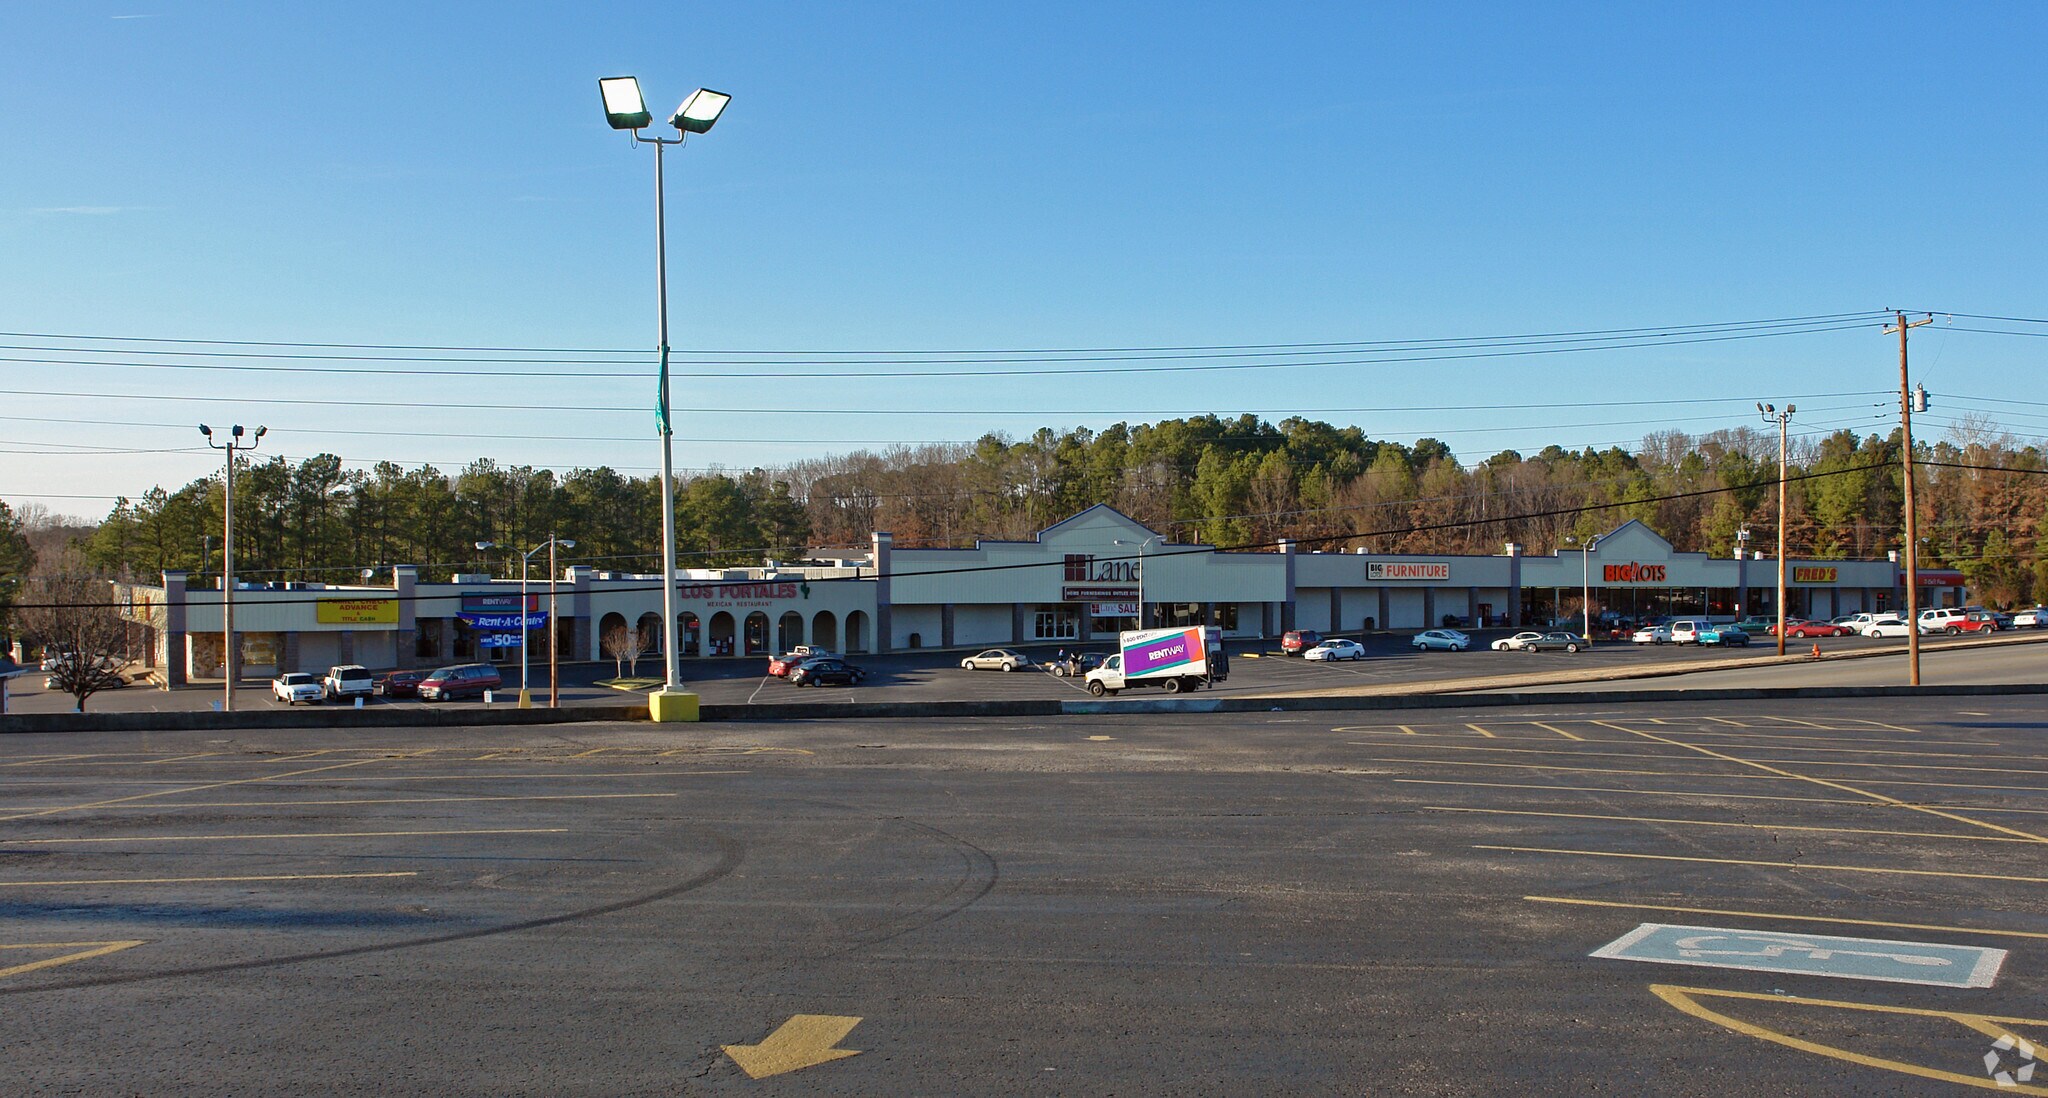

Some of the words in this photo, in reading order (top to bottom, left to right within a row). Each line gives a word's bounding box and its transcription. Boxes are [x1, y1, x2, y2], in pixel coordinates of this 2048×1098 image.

[1087, 554, 1143, 582] Lane
[1386, 565, 1447, 577] FURNITURE
[1796, 567, 1837, 581] FRED'S
[681, 583, 714, 599] LOS
[719, 583, 798, 599] PORTALES
[1118, 603, 1140, 613] SALE
[1148, 644, 1185, 661] RENTWAY
